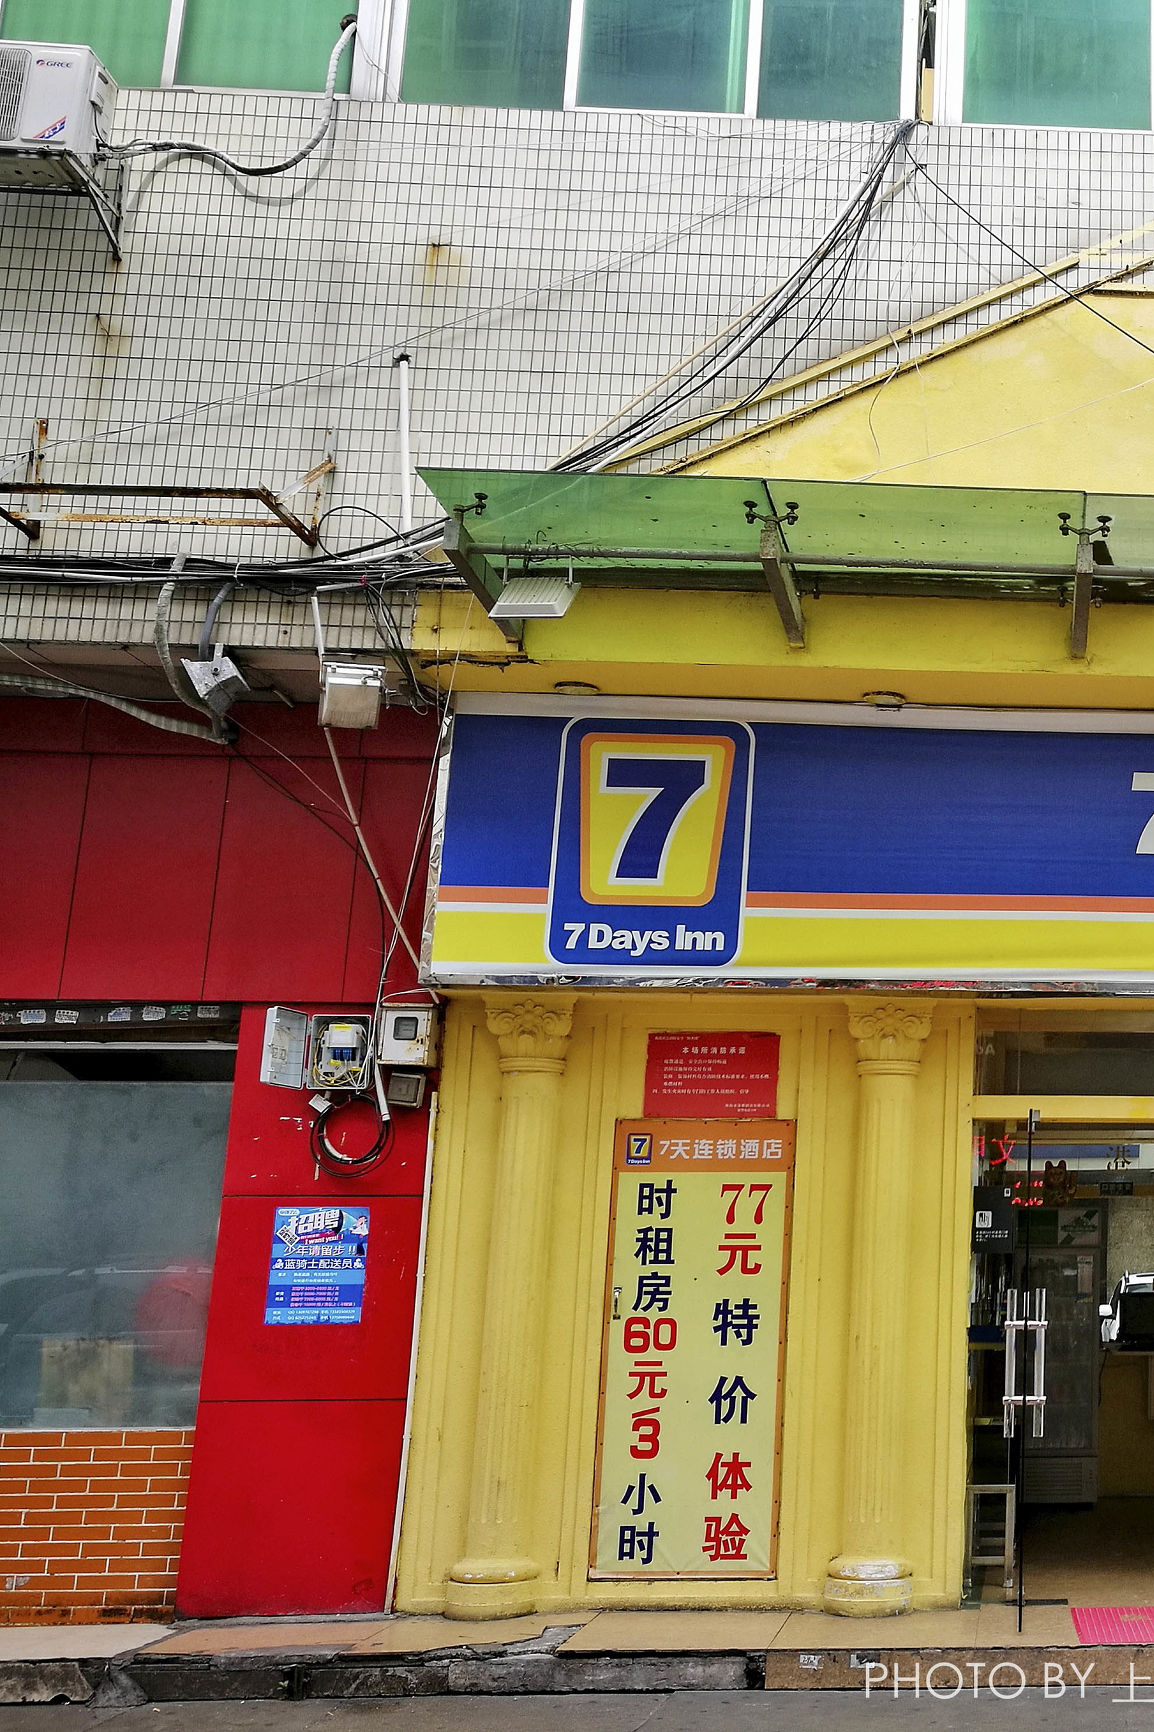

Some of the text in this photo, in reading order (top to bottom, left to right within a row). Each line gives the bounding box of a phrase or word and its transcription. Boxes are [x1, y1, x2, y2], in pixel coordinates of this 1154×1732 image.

[600, 752, 713, 886] 7
[563, 923, 725, 957] 7 Days Inn
[632, 1138, 647, 1155] 7
[659, 1139, 783, 1160] 7天连锁酒店
[288, 1209, 340, 1235] 招聘
[284, 1259, 353, 1269] 蓝骑士配送员
